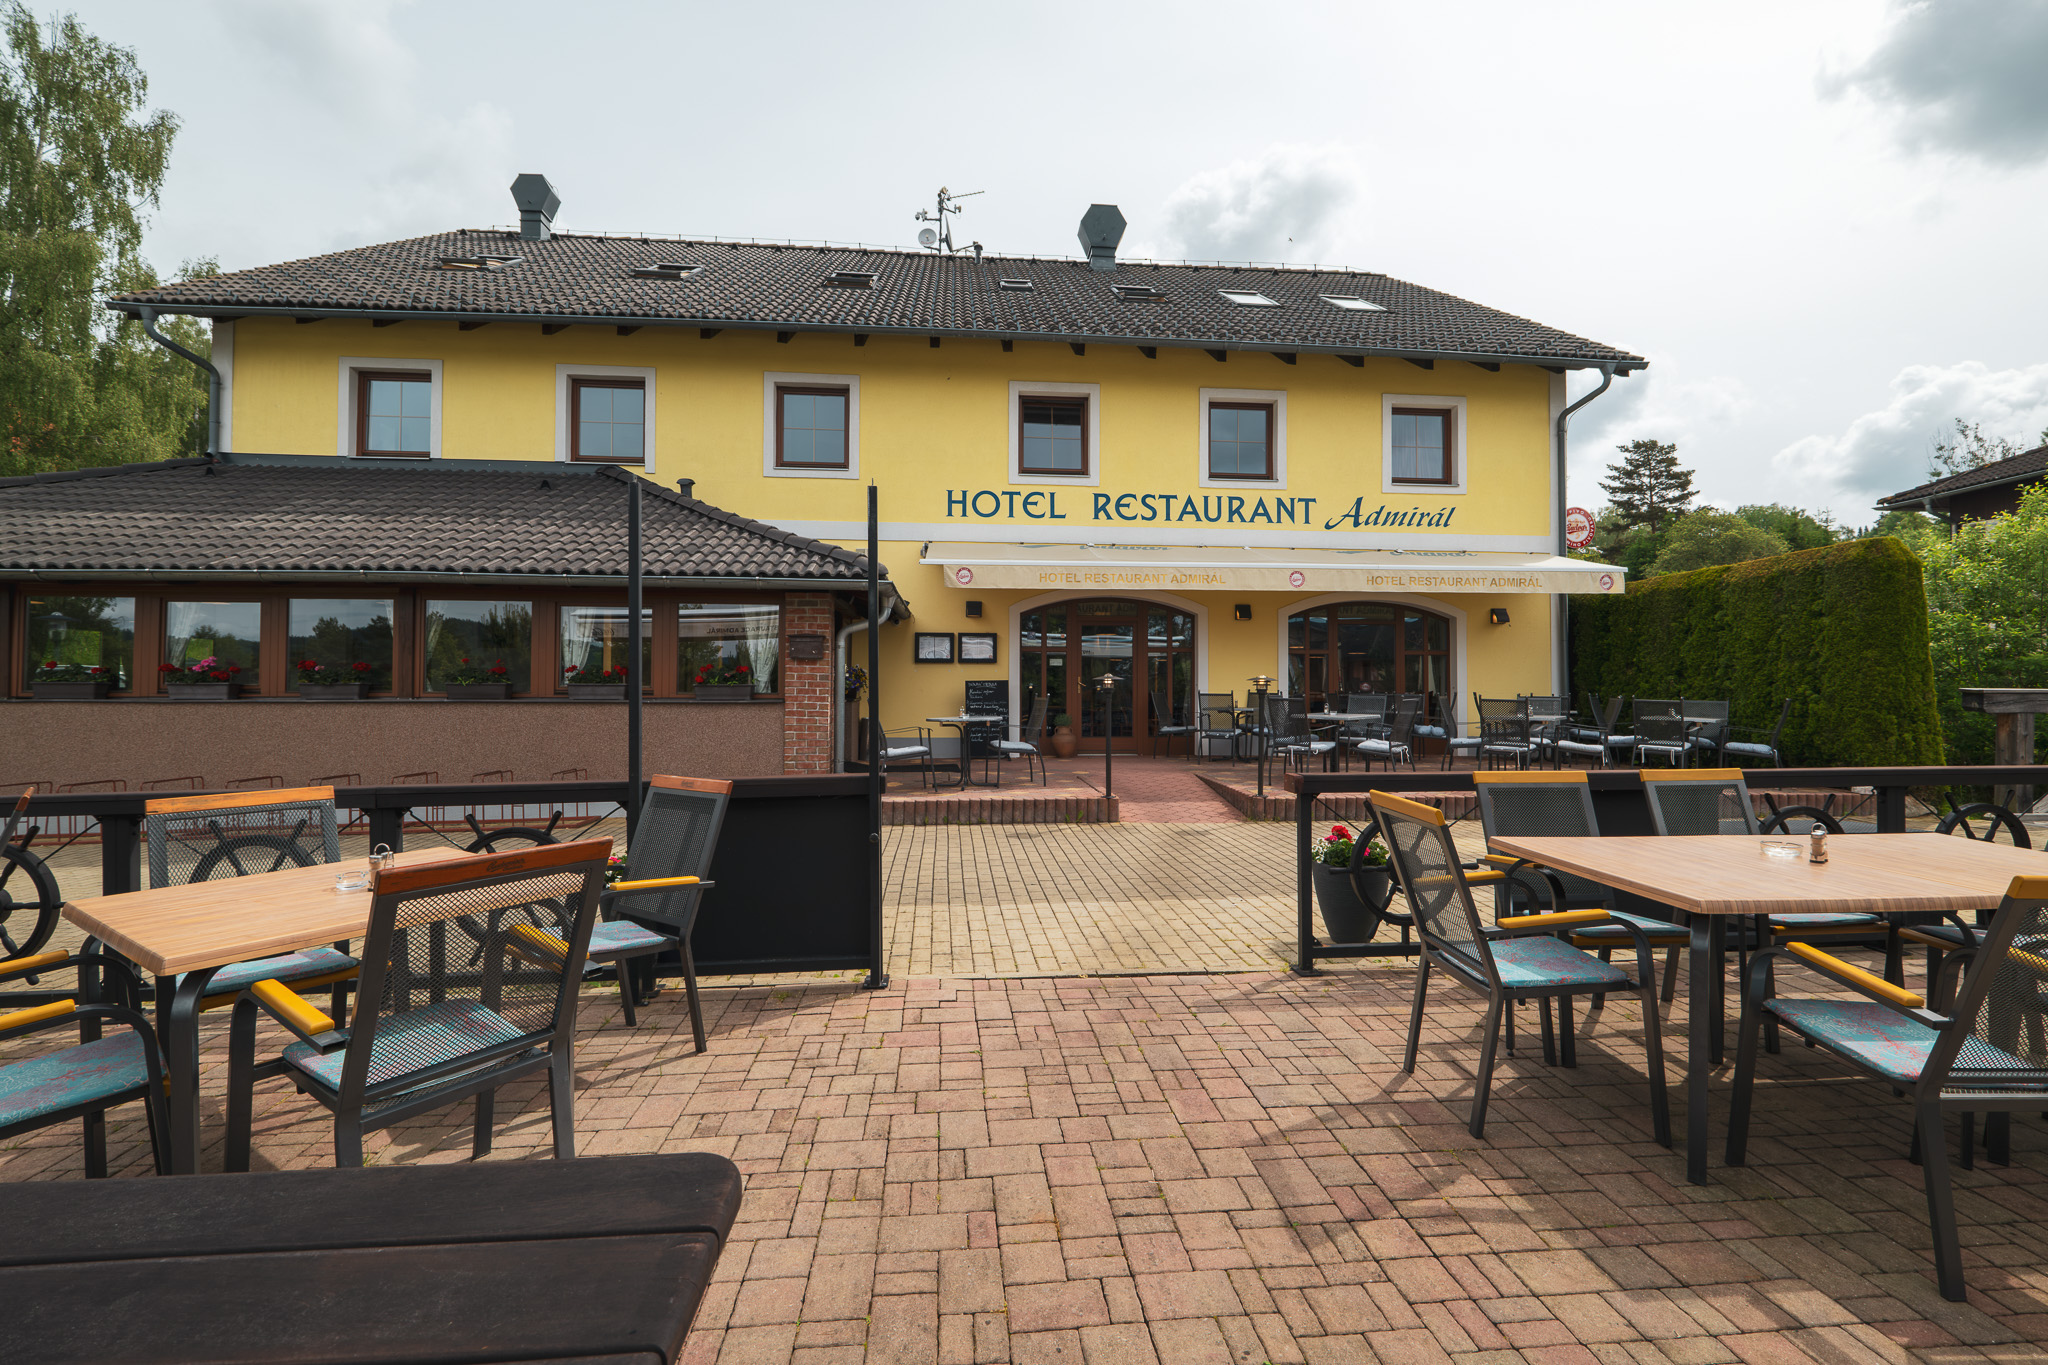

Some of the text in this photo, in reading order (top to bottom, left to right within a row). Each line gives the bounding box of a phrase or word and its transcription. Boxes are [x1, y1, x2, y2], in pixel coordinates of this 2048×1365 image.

[946, 489, 1456, 530] HOTEL RESTAURANT Admirál
[1039, 571, 1226, 584] HOTEL RESTAURANT ADMIRÁL
[1366, 575, 1542, 588] HOTEL RESTAURANT ADMIRÁL
